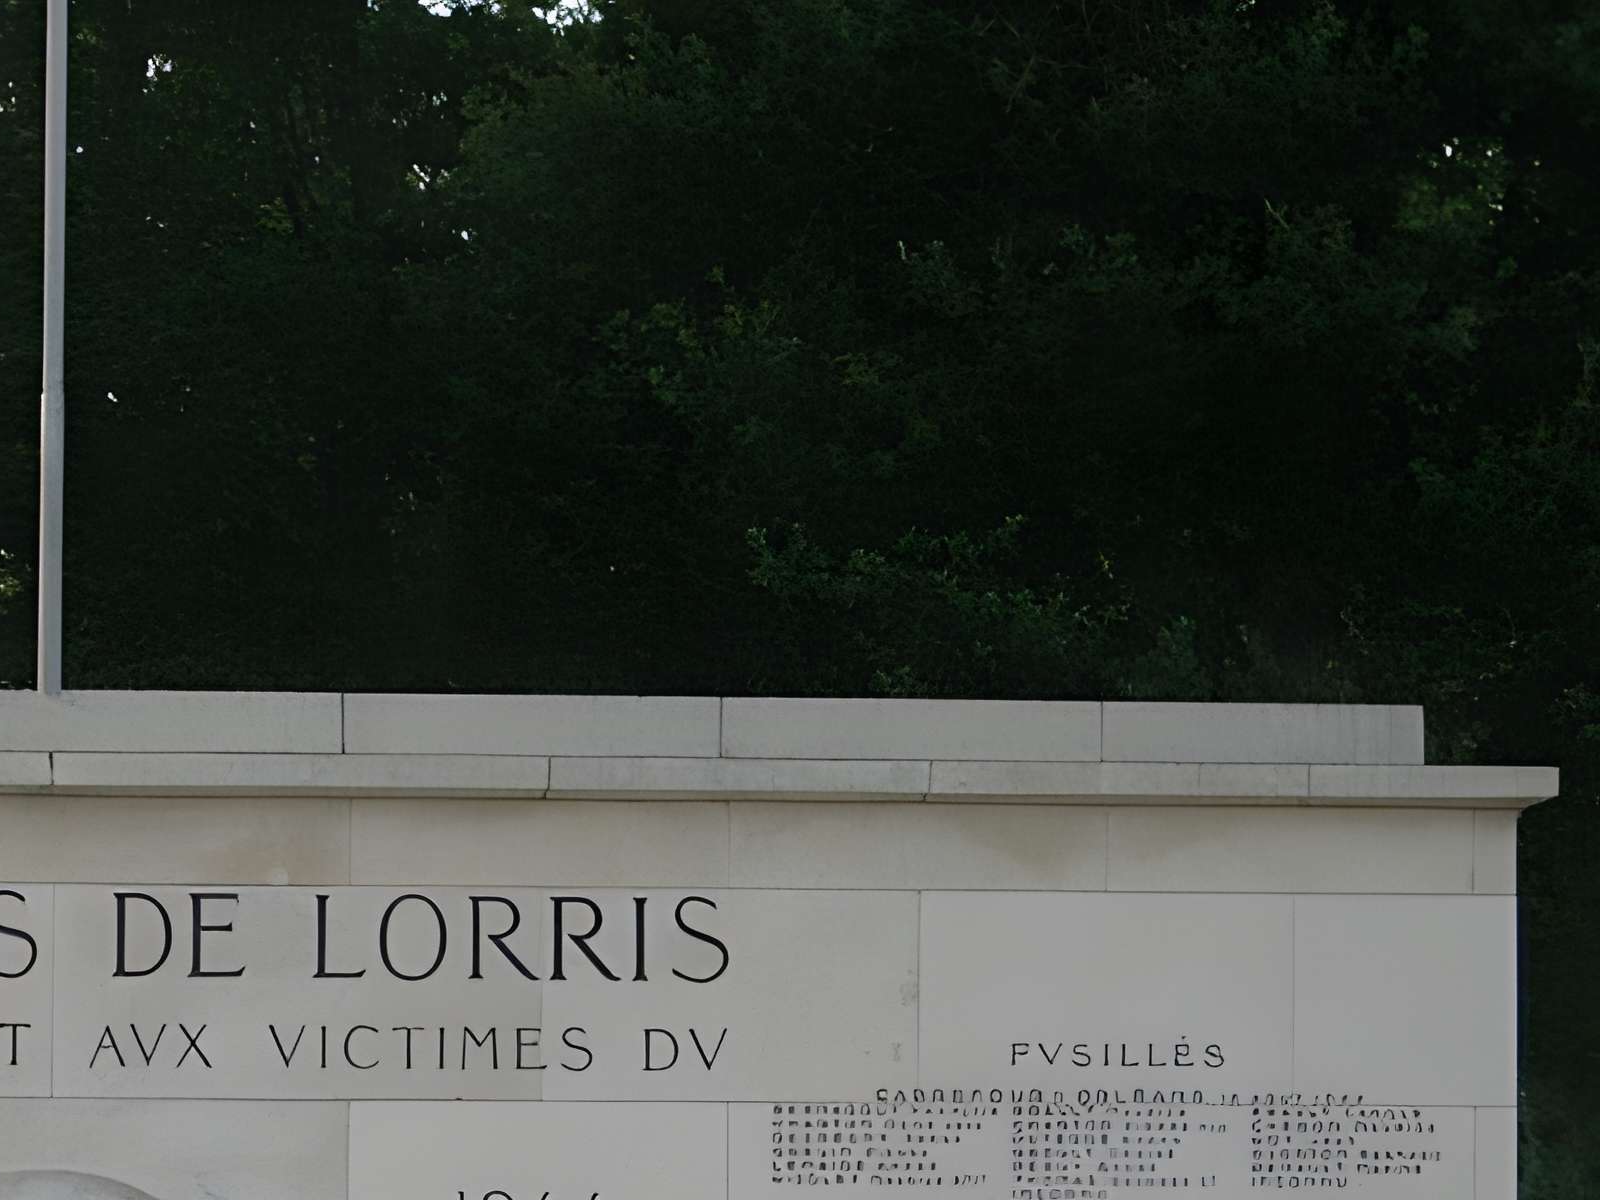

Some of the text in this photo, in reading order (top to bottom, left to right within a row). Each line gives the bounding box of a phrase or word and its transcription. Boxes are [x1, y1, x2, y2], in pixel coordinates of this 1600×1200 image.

[112, 892, 246, 978] DE
[313, 894, 730, 983] LORRIS
[89, 1024, 213, 1070] AVX
[268, 1024, 594, 1072] VICTIMES
[642, 1028, 728, 1072] DV
